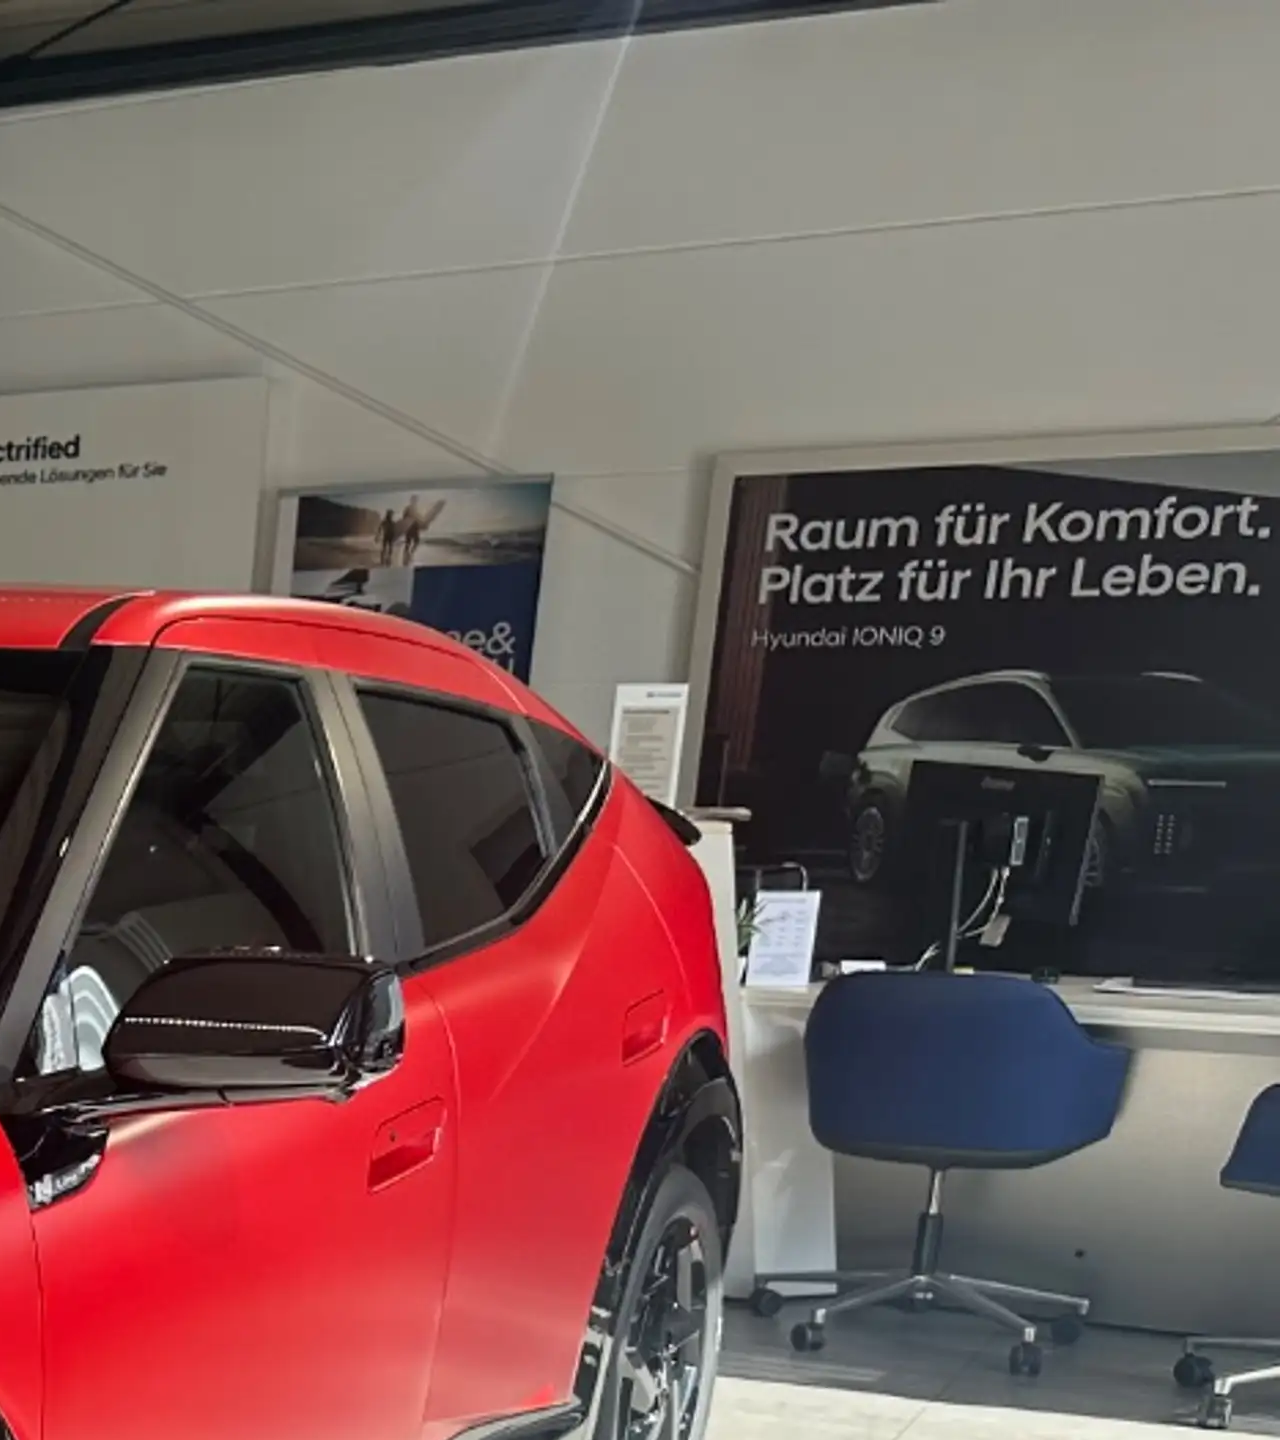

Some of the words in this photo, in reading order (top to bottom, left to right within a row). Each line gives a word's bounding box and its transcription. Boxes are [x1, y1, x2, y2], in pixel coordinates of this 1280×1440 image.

[40, 467, 115, 484] Lösungen
[117, 463, 140, 480] für
[142, 461, 168, 478] Sie
[765, 511, 919, 553] Raum
[934, 503, 1010, 547] für
[1023, 495, 1272, 544] Komfort.
[758, 565, 883, 604] Platz
[898, 560, 971, 603] für
[983, 557, 1057, 600] Ihr
[1070, 553, 1262, 598] Leben.
[750, 627, 847, 650] Hyundai
[851, 625, 924, 649] IONIQ
[930, 625, 946, 647] 9
